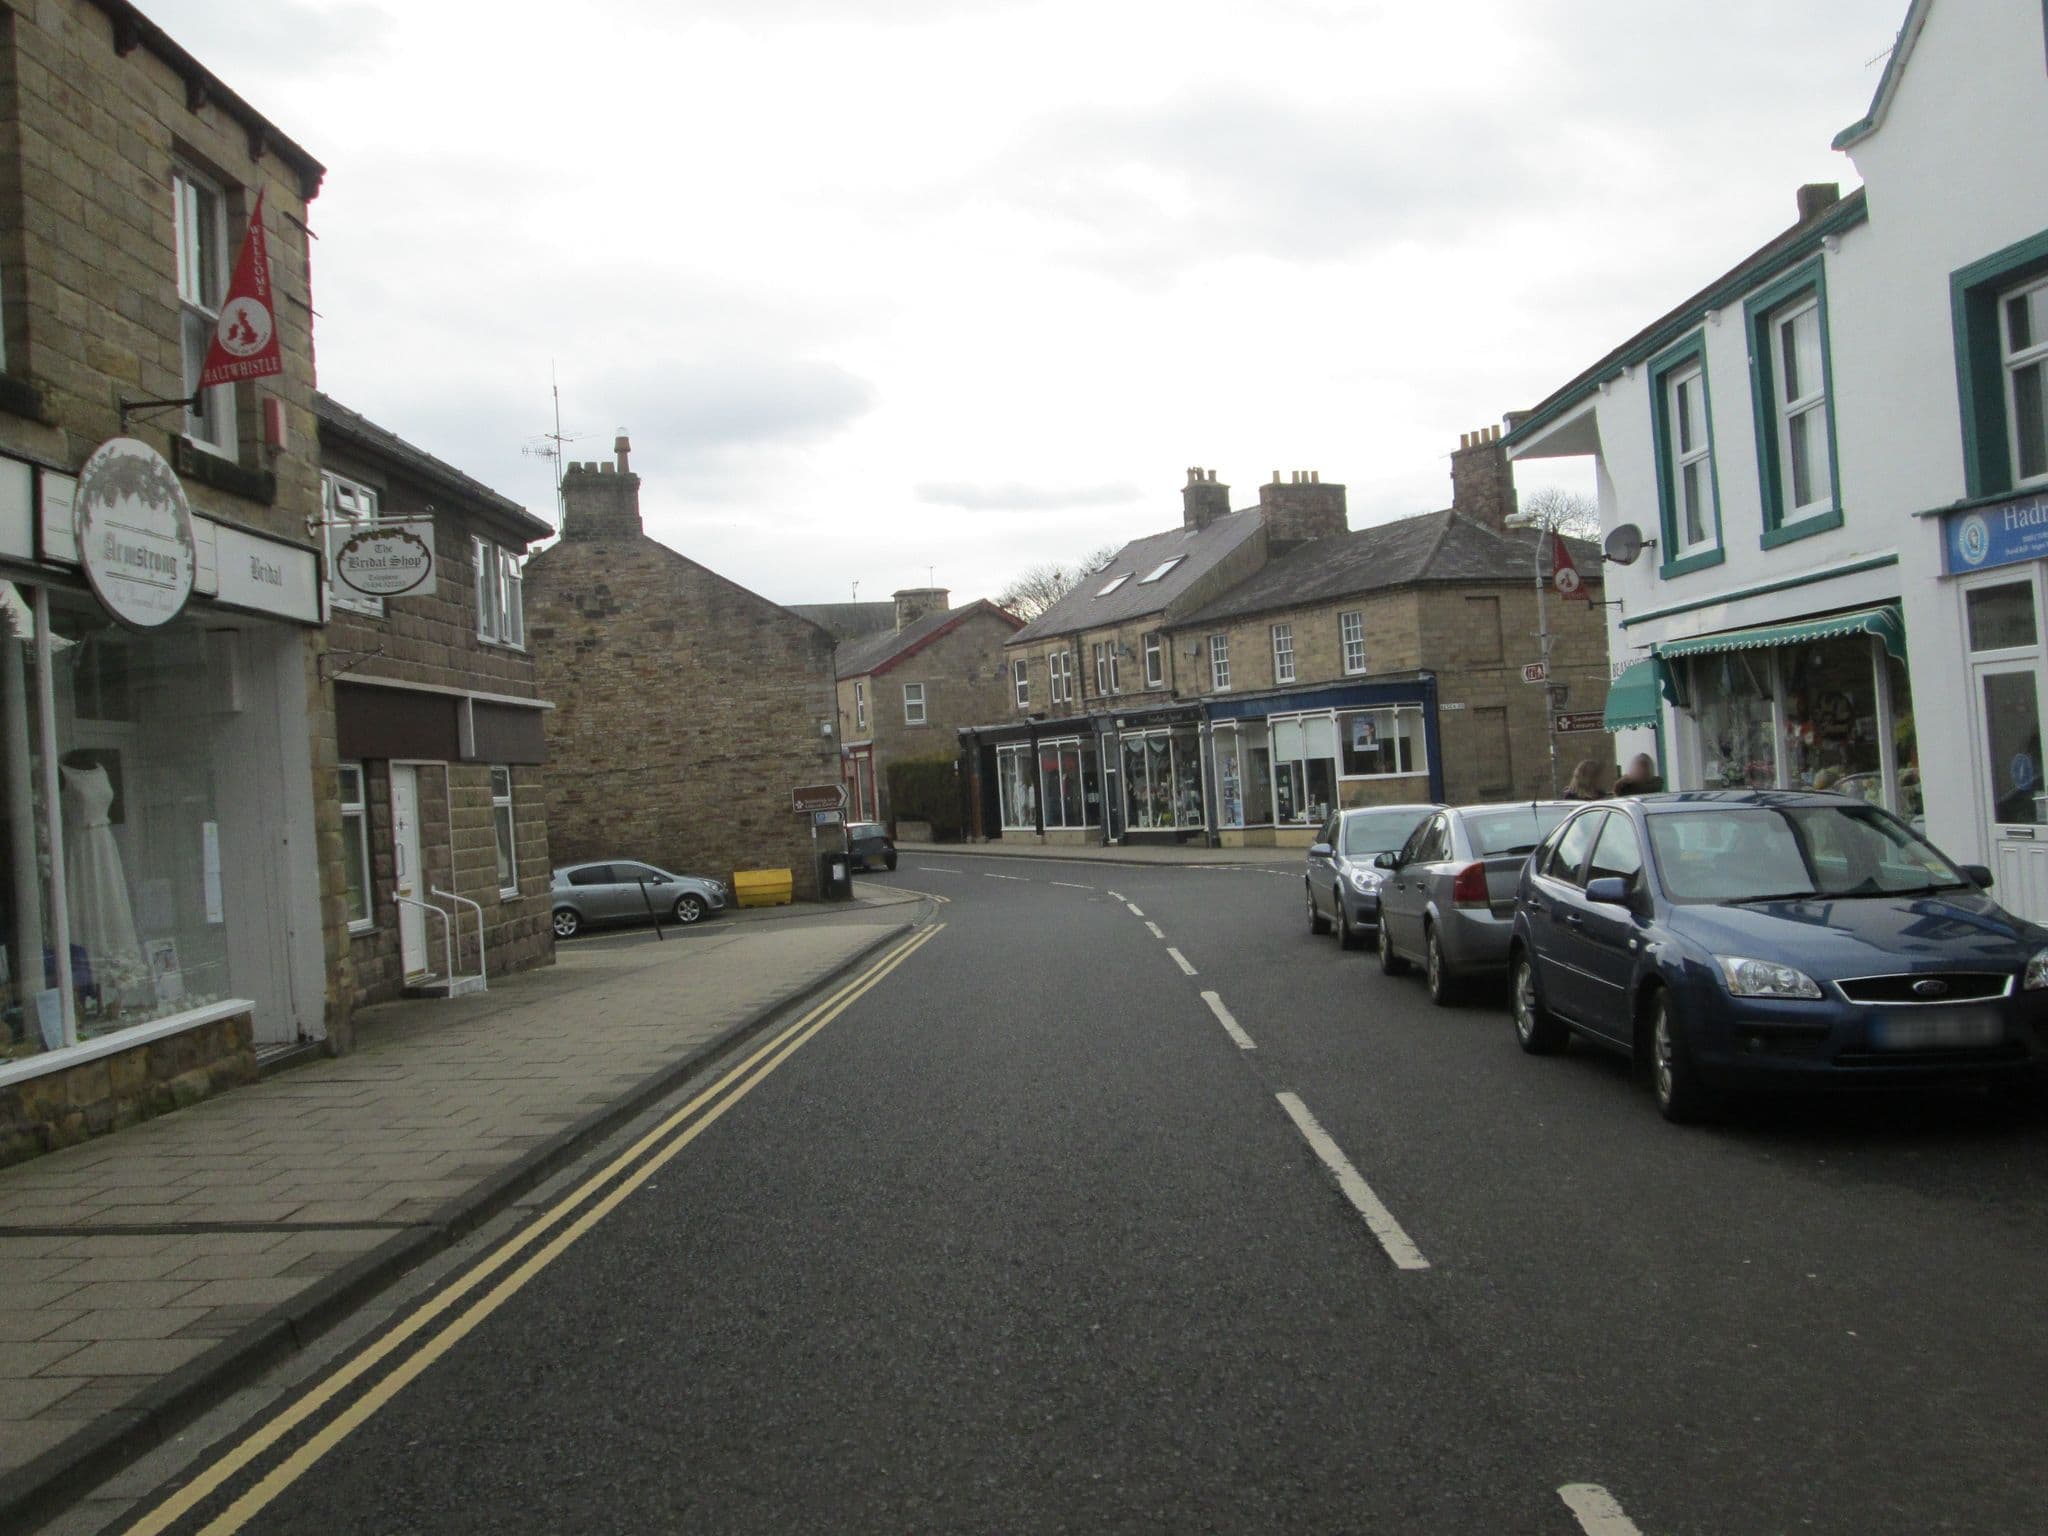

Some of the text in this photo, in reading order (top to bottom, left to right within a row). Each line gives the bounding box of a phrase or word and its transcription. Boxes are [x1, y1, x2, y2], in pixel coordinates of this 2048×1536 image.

[251, 225, 266, 296] WELCOME
[204, 357, 280, 382] HALTWHISTLE
[104, 531, 178, 580] Armstrong
[374, 543, 394, 553] The
[348, 555, 422, 569] Bridal Shop
